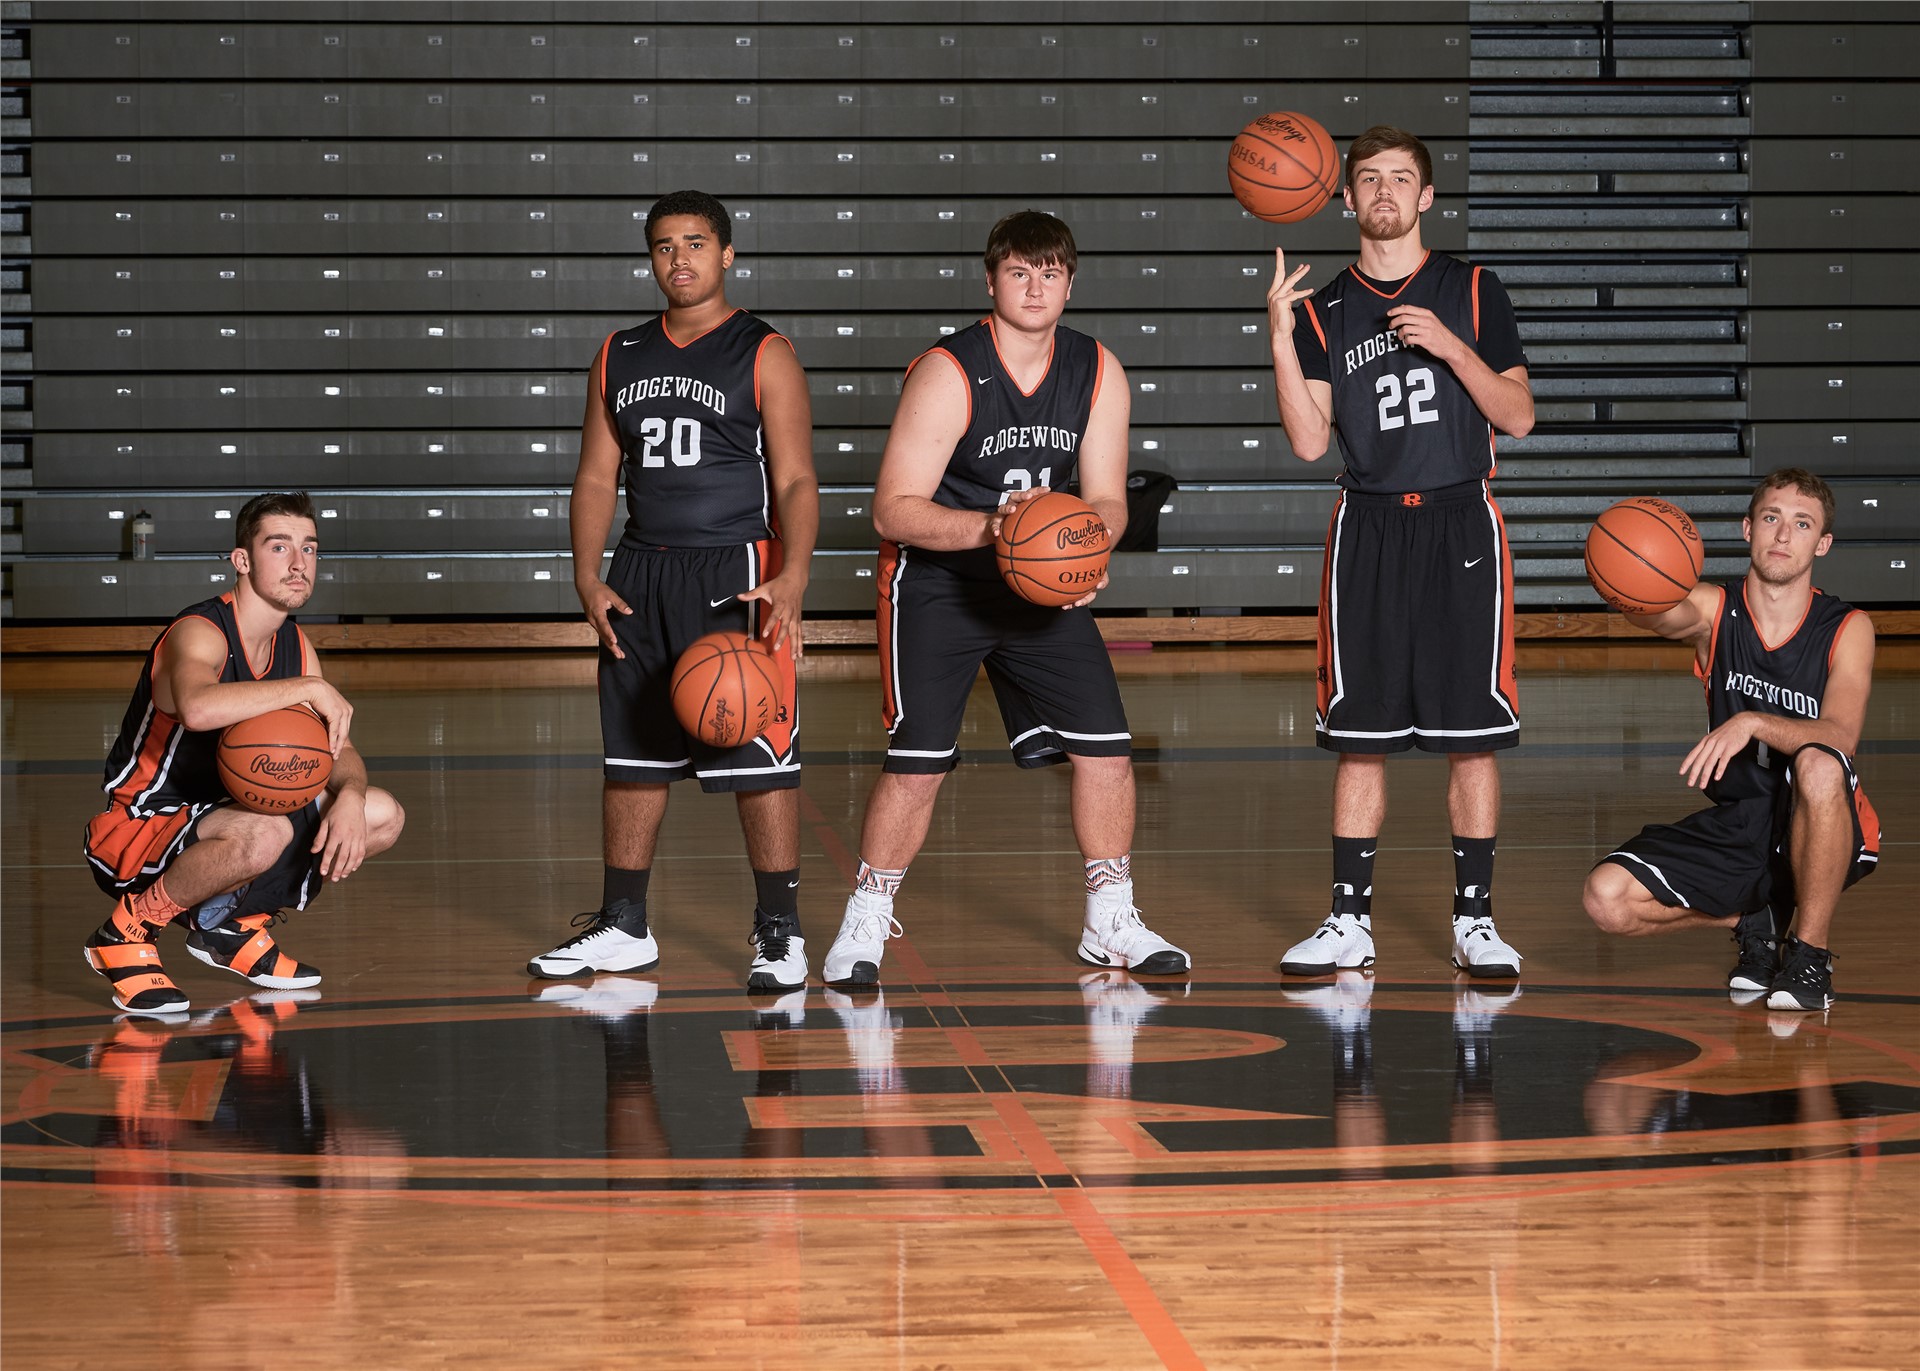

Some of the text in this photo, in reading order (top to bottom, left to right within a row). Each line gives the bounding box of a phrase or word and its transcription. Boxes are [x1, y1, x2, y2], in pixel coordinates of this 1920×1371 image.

[1232, 143, 1279, 176] OHSAA
[1344, 330, 1415, 376] RIDGE
[616, 376, 726, 416] RIDGEWOOD
[1375, 367, 1440, 432] 22
[640, 417, 702, 468] 20
[1057, 519, 1106, 550] Rawling
[1636, 498, 1698, 542] Rawlings
[1725, 670, 1819, 720] RDGEWOOD
[250, 753, 322, 778] Rawlings
[244, 791, 310, 808] OHSAA
[151, 978, 164, 986] MG
